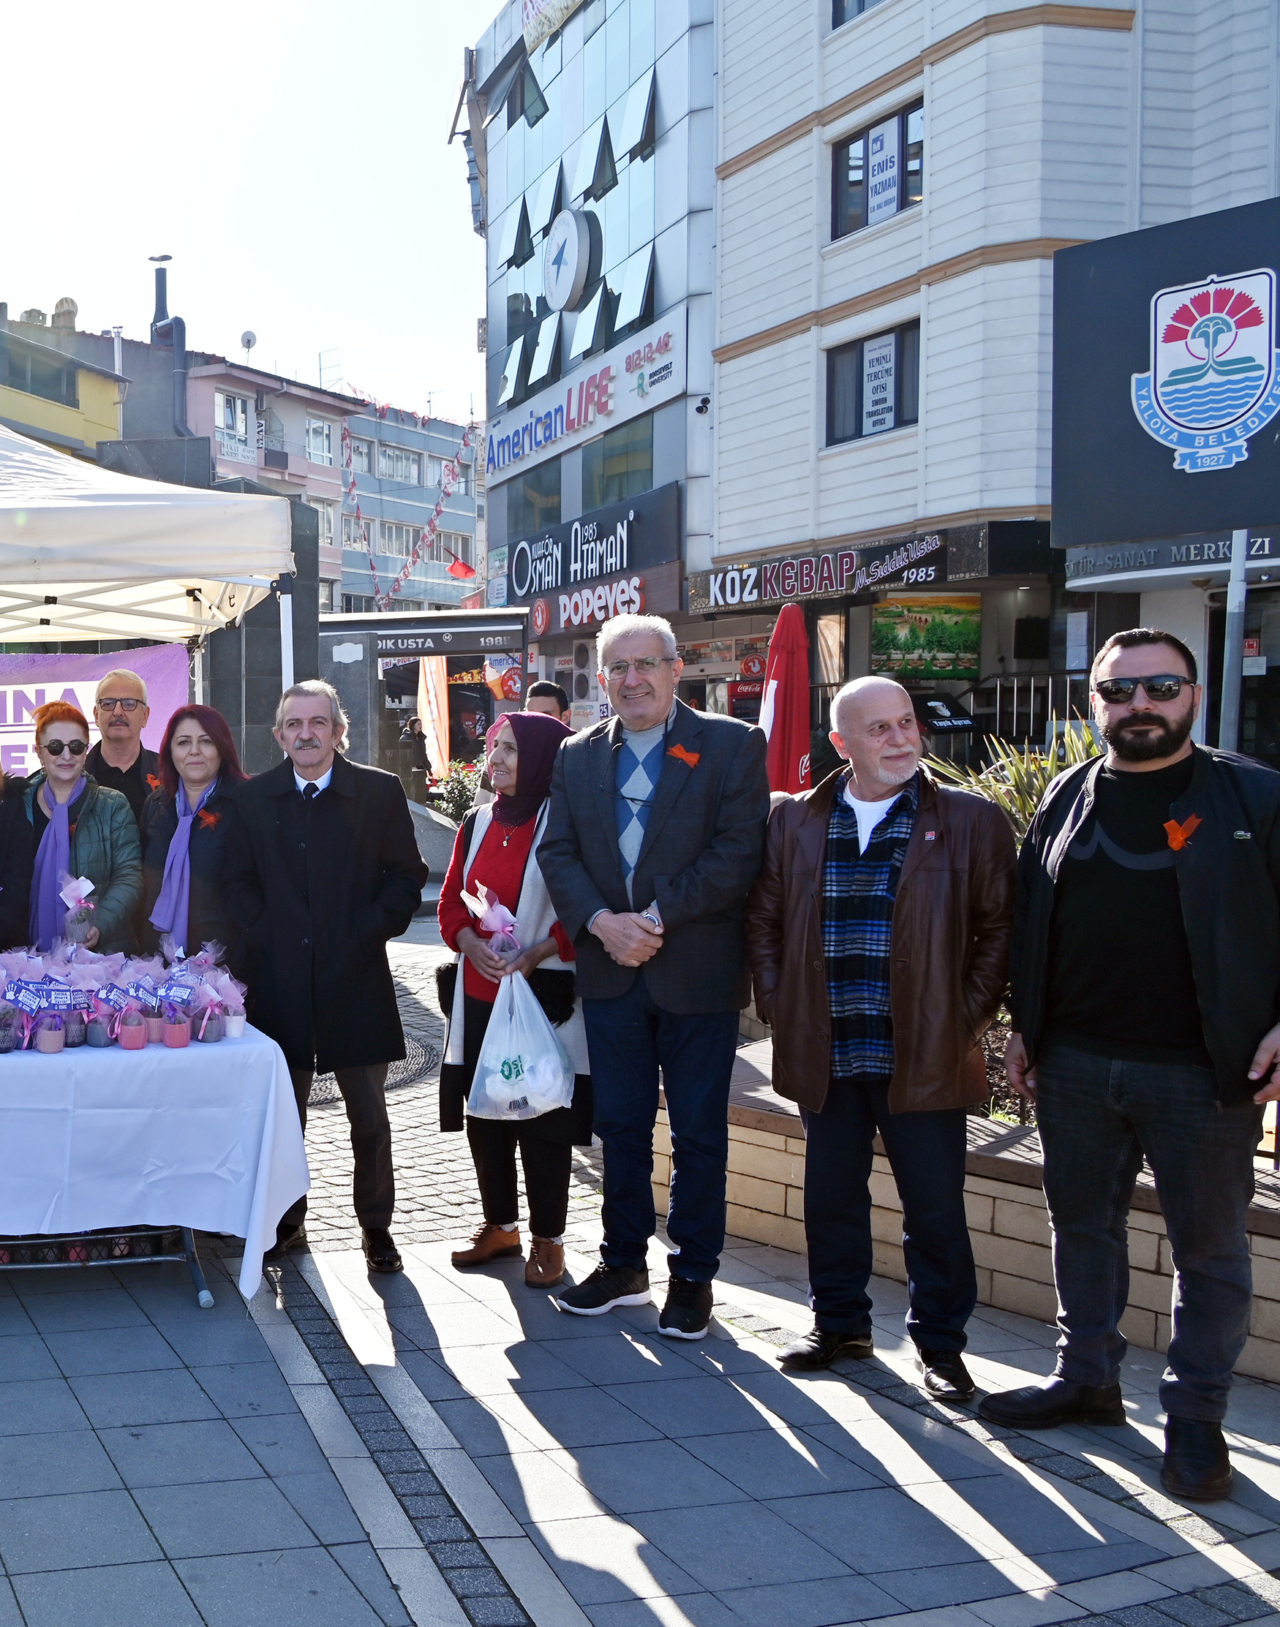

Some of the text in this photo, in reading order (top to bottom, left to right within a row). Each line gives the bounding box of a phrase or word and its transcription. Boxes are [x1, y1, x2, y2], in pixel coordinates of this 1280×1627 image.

[872, 155, 895, 178] ENİS
[870, 174, 896, 198] YAZMAN
[625, 332, 671, 373] 812 12 46
[649, 370, 672, 388] UNIVERSITY
[1138, 368, 1280, 447] YALOVA BELEDİYE
[1195, 455, 1225, 467] 1927
[581, 522, 597, 542] 1985
[513, 541, 562, 597] OSMAN
[570, 520, 628, 583] ATAMAN
[1171, 537, 1271, 563] MERKZI
[761, 551, 856, 600] KEBAP
[902, 566, 935, 583] 1985
[559, 576, 643, 629] POPEYES
[398, 638, 434, 649] USTA
[738, 683, 761, 692] Coca-Cola
[953, 718, 972, 726] Ayran
